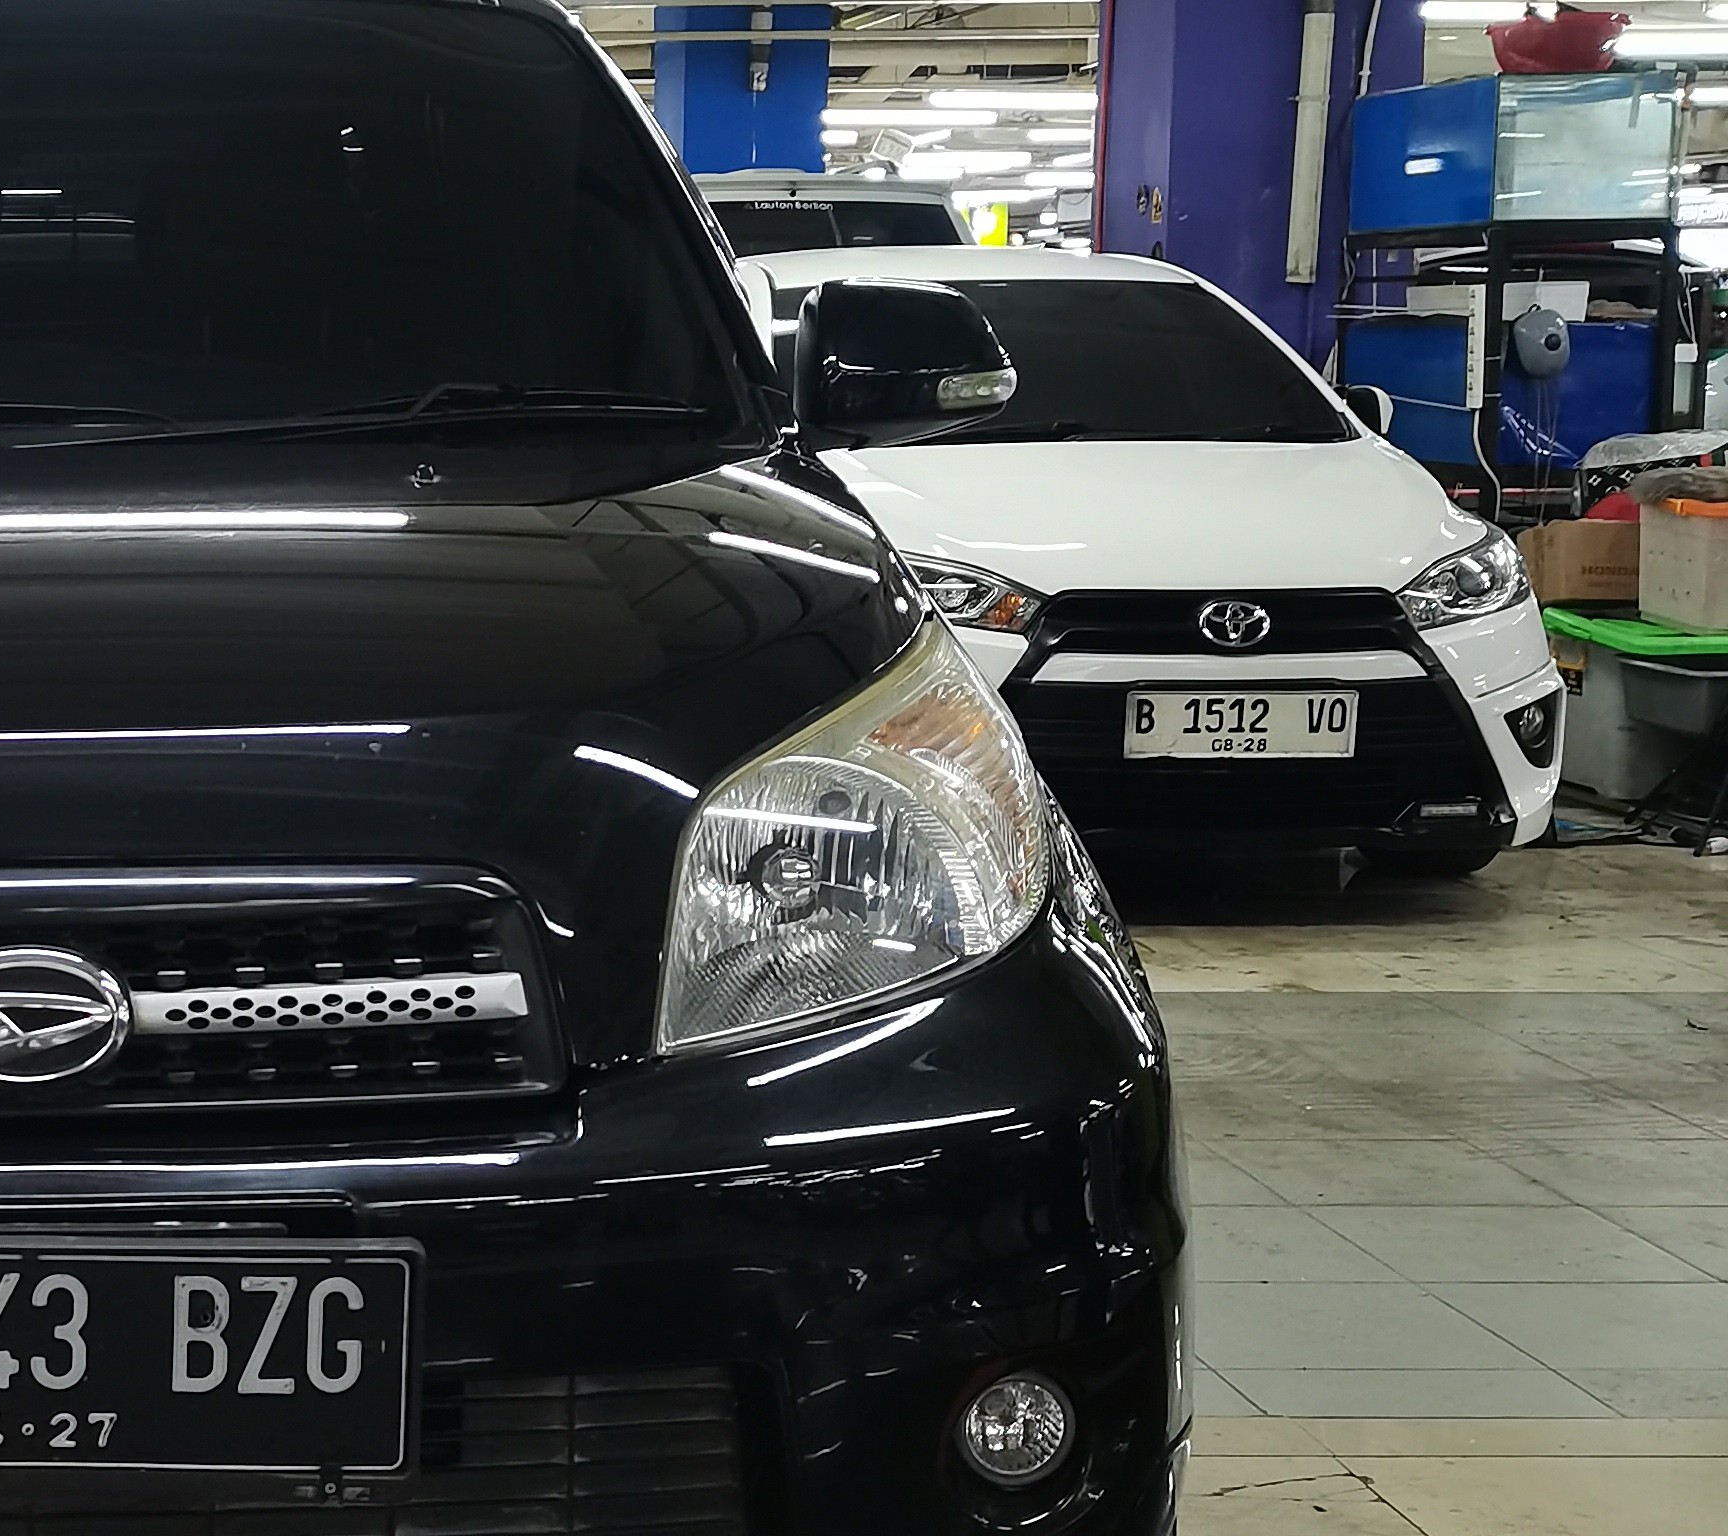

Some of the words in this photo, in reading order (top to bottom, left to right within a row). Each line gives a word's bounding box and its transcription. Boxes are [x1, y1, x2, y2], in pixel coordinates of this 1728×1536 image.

[1135, 699, 1155, 734] B
[1182, 698, 1270, 734] 1512
[1307, 698, 1347, 734] VO
[171, 1275, 364, 1394] BZG
